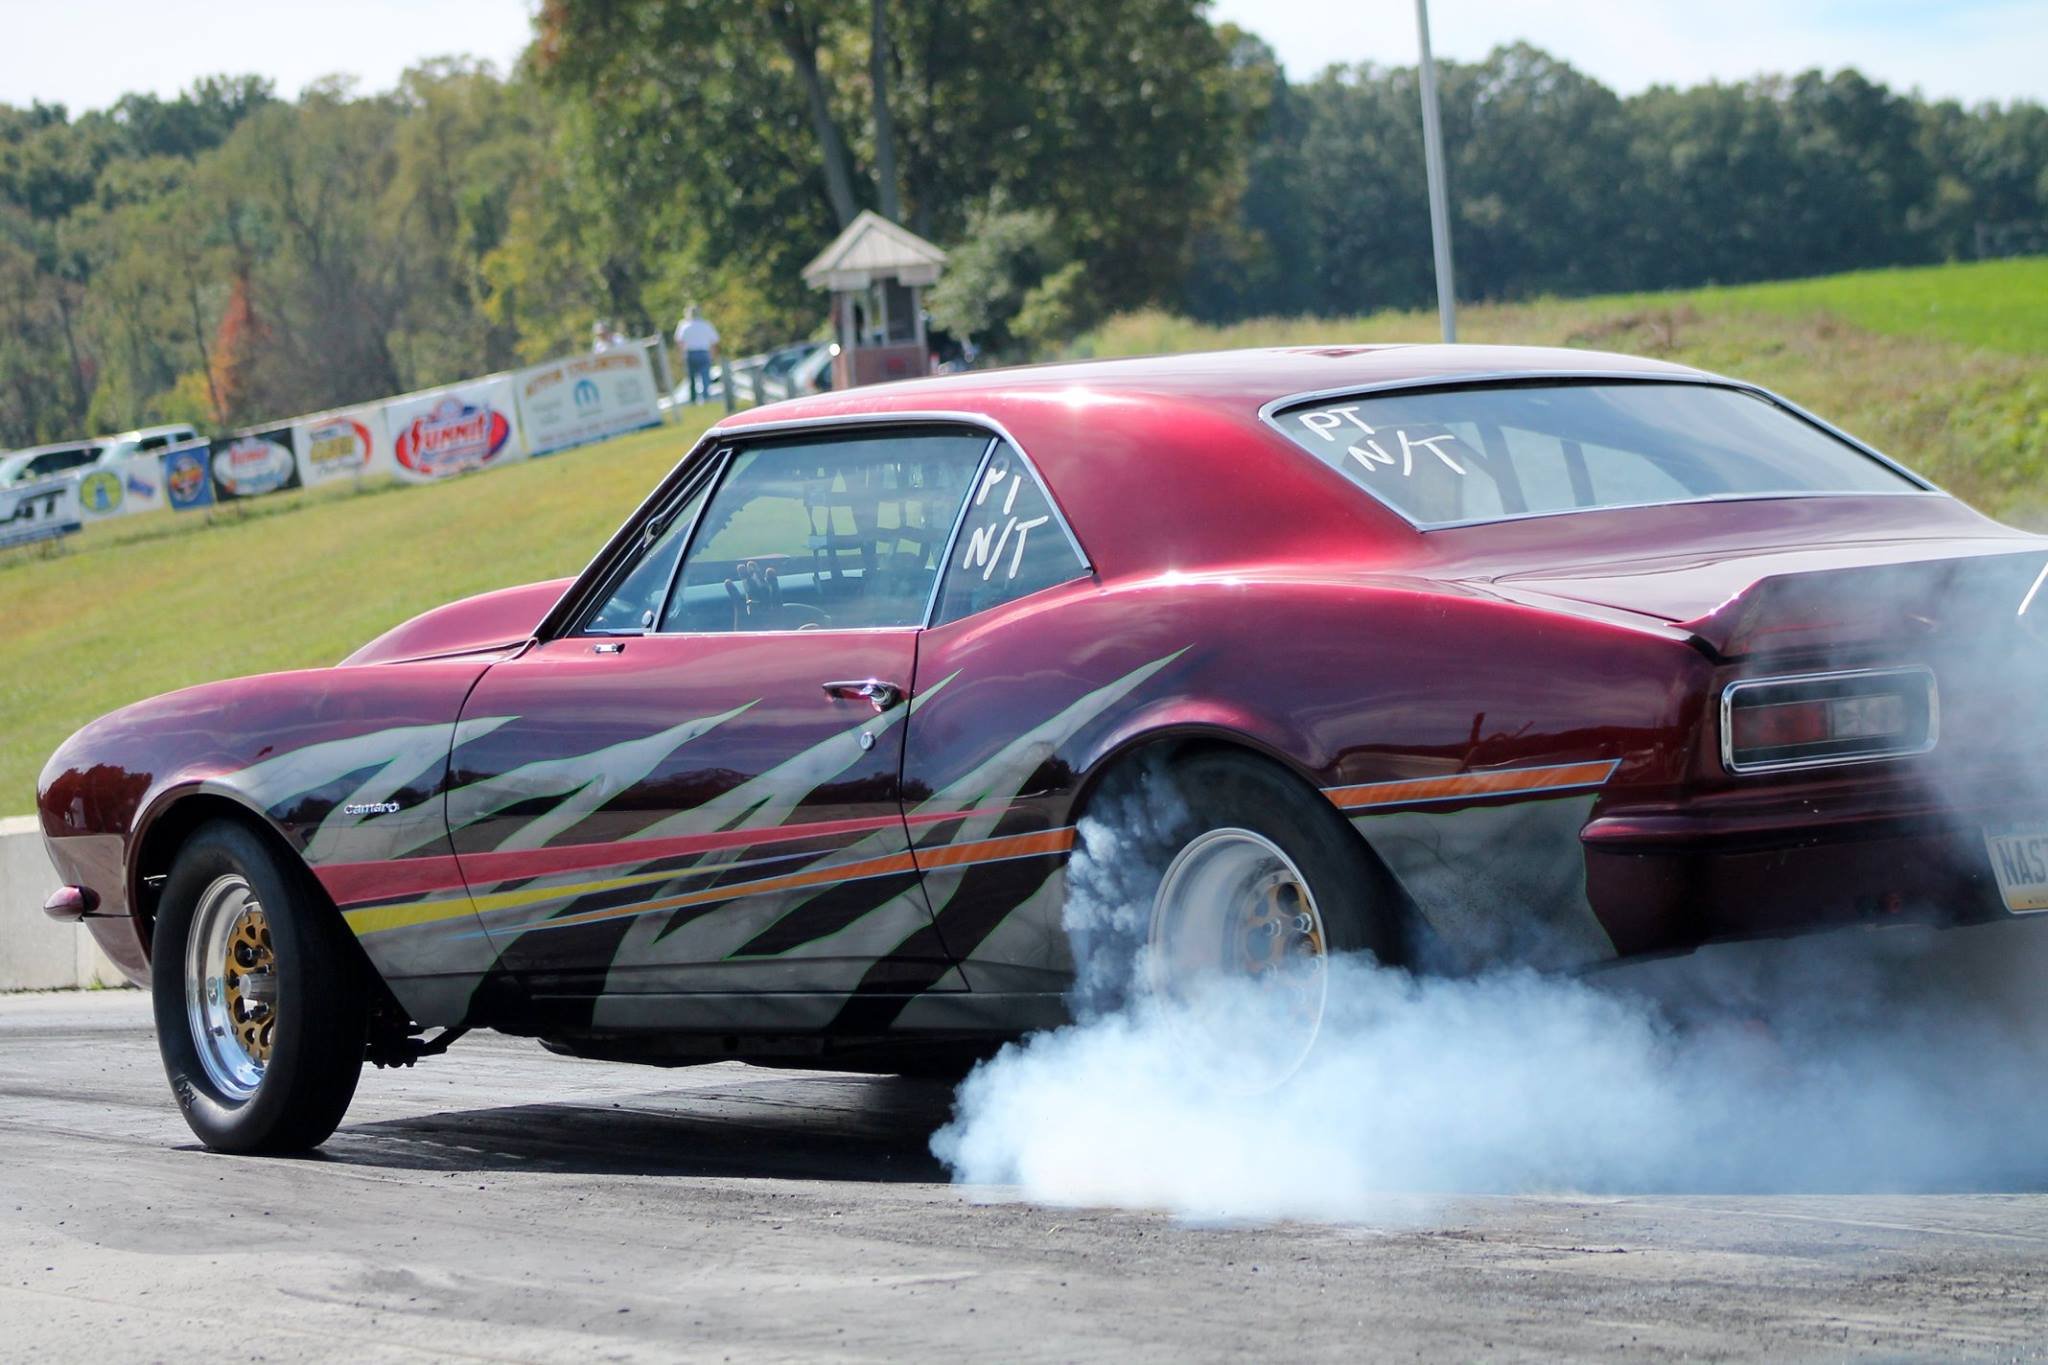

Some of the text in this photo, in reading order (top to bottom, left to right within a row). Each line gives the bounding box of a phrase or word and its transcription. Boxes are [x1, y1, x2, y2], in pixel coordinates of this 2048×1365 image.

[1299, 406, 1375, 442] PT
[1348, 430, 1467, 477] N/T
[963, 515, 1049, 581] N/T
[1996, 839, 2048, 886] NAS
